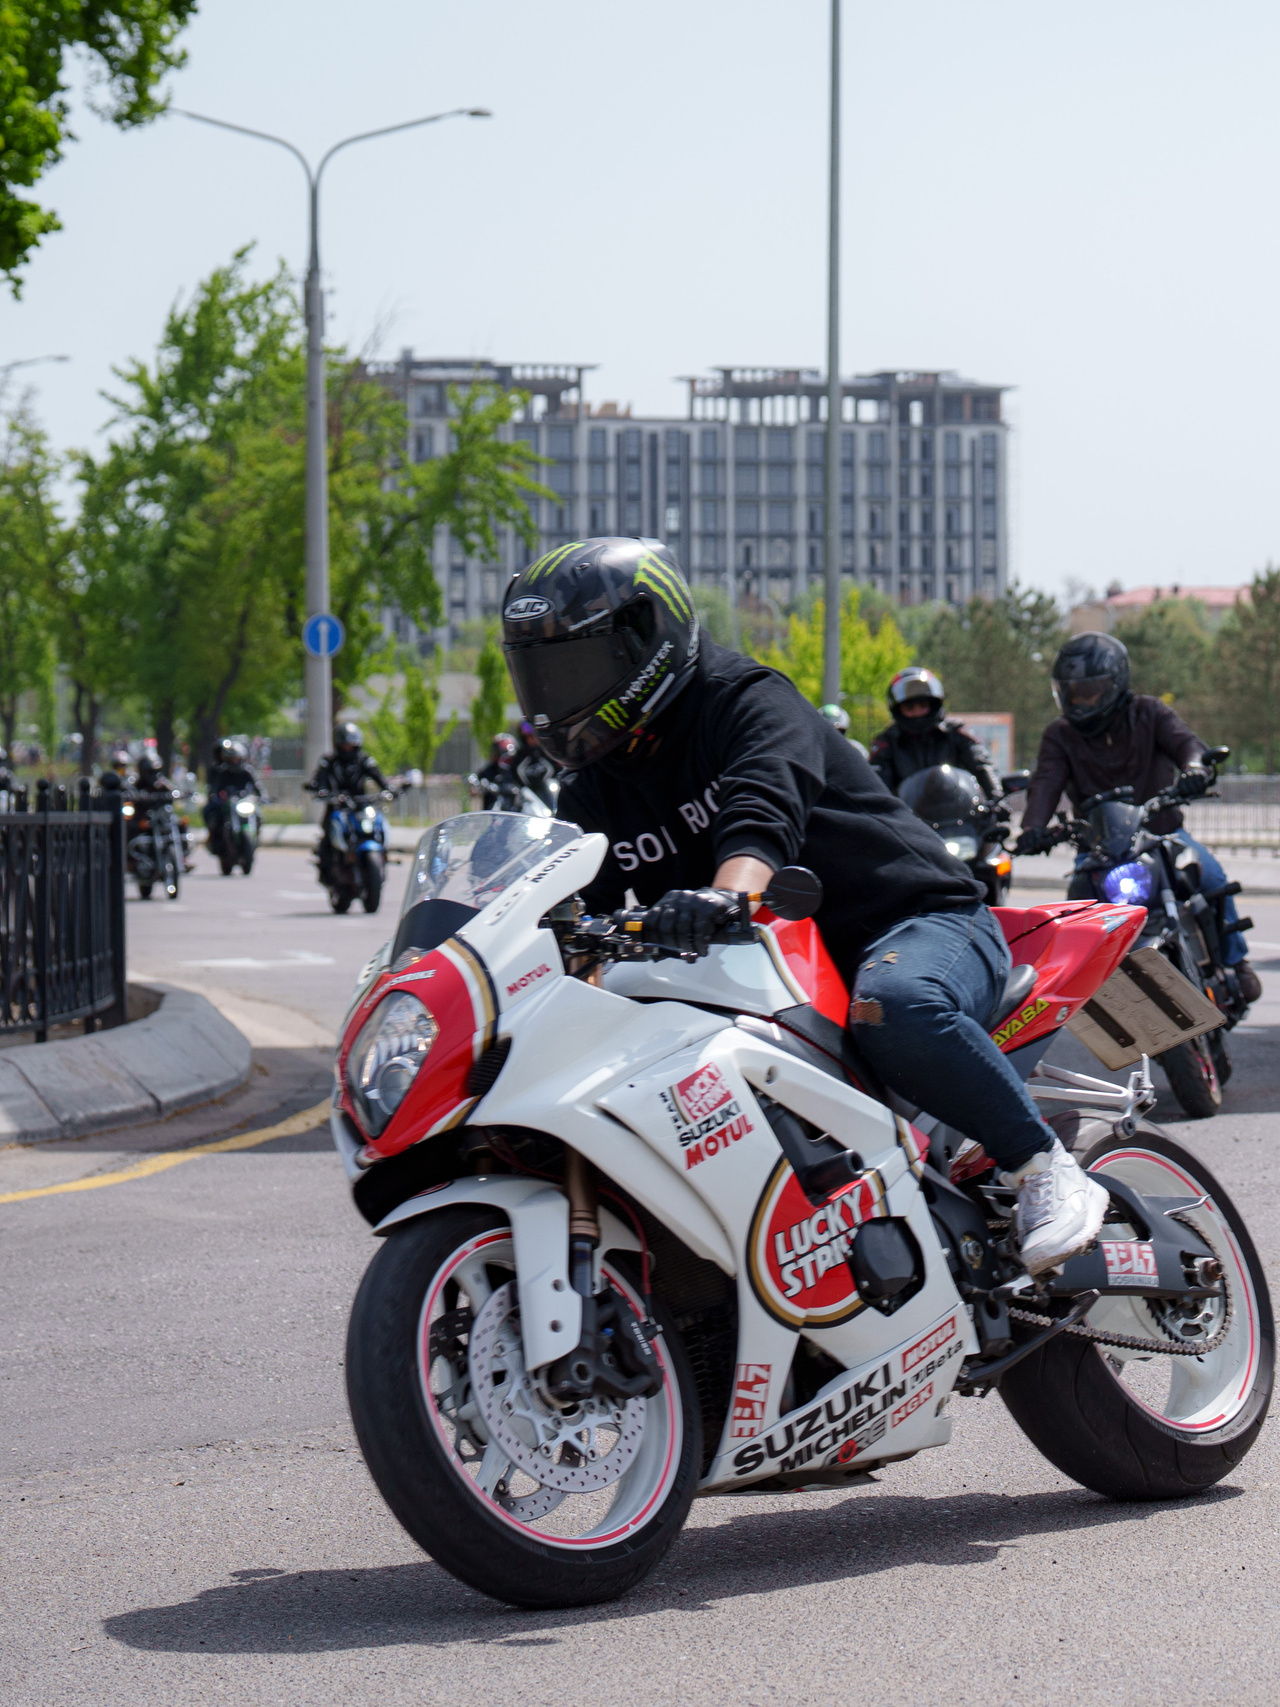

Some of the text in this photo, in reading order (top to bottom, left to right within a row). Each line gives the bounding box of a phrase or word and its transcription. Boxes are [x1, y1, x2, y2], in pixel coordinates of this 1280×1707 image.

[619, 641, 674, 704] MONSTER
[530, 847, 580, 884] MOTUL
[505, 963, 553, 997] MOTUL
[679, 1100, 742, 1147] SUZUKI
[685, 1113, 755, 1171] MOTUL
[774, 1184, 864, 1267] LUCKY
[780, 1226, 859, 1299] STRIK
[1102, 1243, 1156, 1274] ヨシムラ
[903, 1318, 955, 1371] MOTUL
[925, 1340, 963, 1379] Beta
[733, 1362, 892, 1476] SUZUKI
[779, 1379, 907, 1473] MICHELIN
[892, 1383, 933, 1427] NGK
